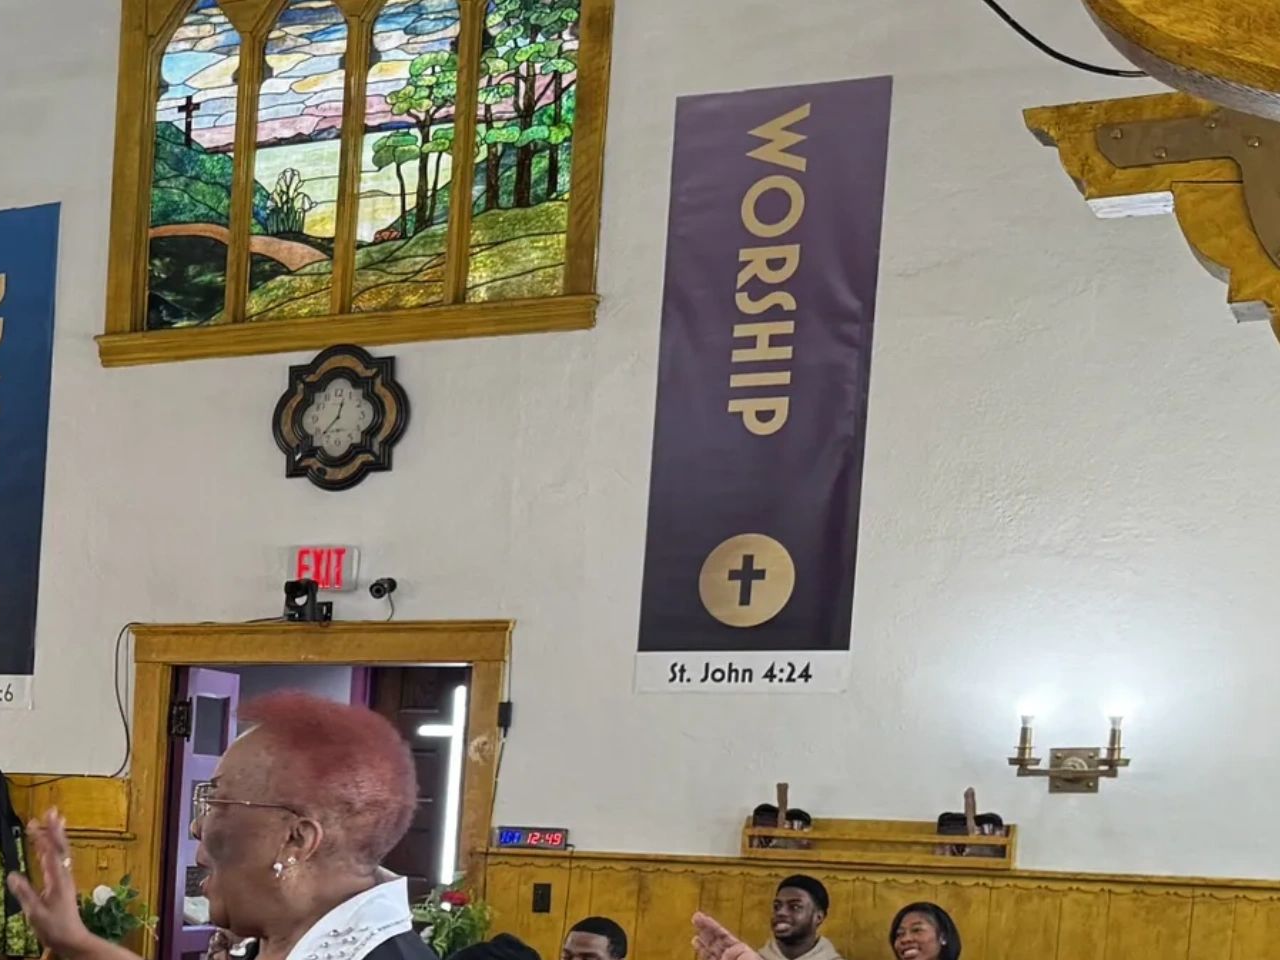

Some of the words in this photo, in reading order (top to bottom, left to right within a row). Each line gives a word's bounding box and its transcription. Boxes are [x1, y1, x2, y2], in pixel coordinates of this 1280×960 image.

[727, 102, 812, 436] WORSHIP
[297, 547, 346, 588] EXIT
[668, 662, 692, 683] St.
[700, 662, 754, 683] John
[761, 661, 813, 683] 4:24
